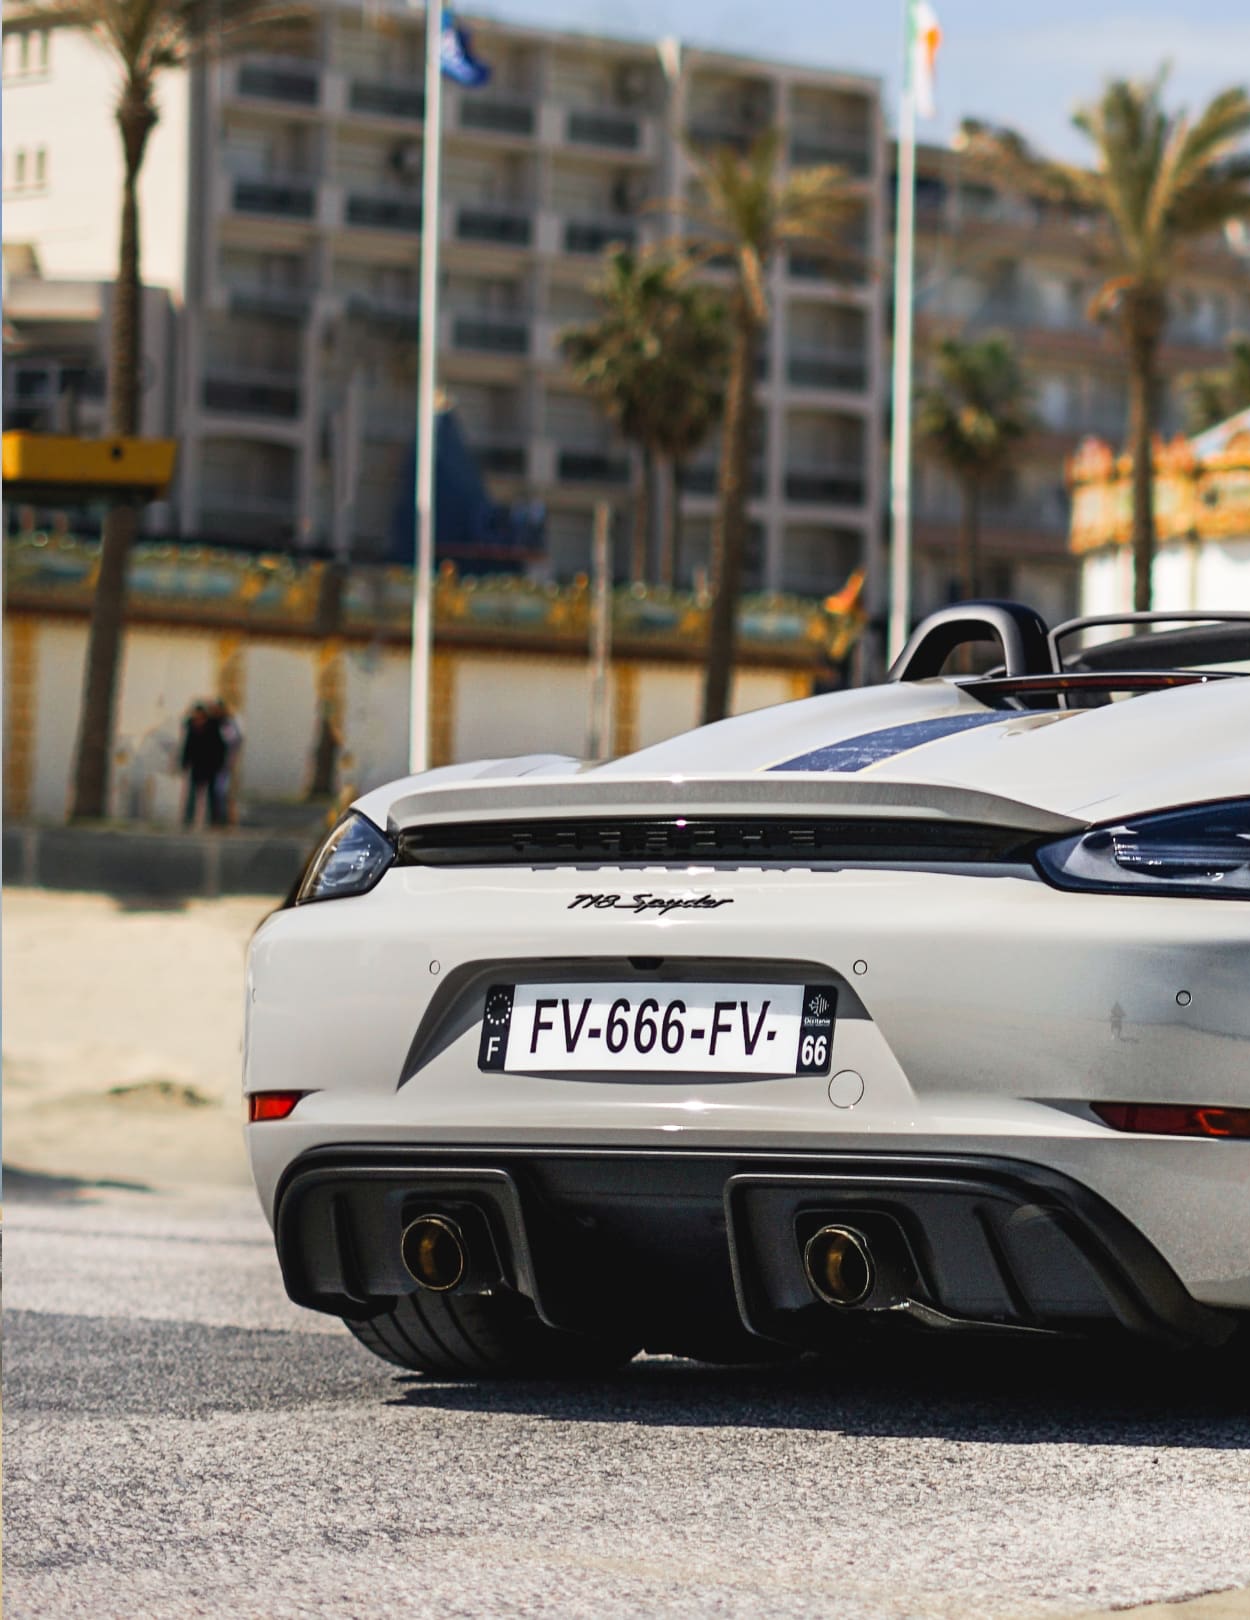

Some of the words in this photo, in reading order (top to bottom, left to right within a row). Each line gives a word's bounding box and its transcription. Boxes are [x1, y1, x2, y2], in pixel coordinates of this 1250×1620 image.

[567, 894, 620, 909] 718
[632, 894, 734, 916] Spyder
[486, 1036, 500, 1062] F
[801, 1035, 827, 1066] 66
